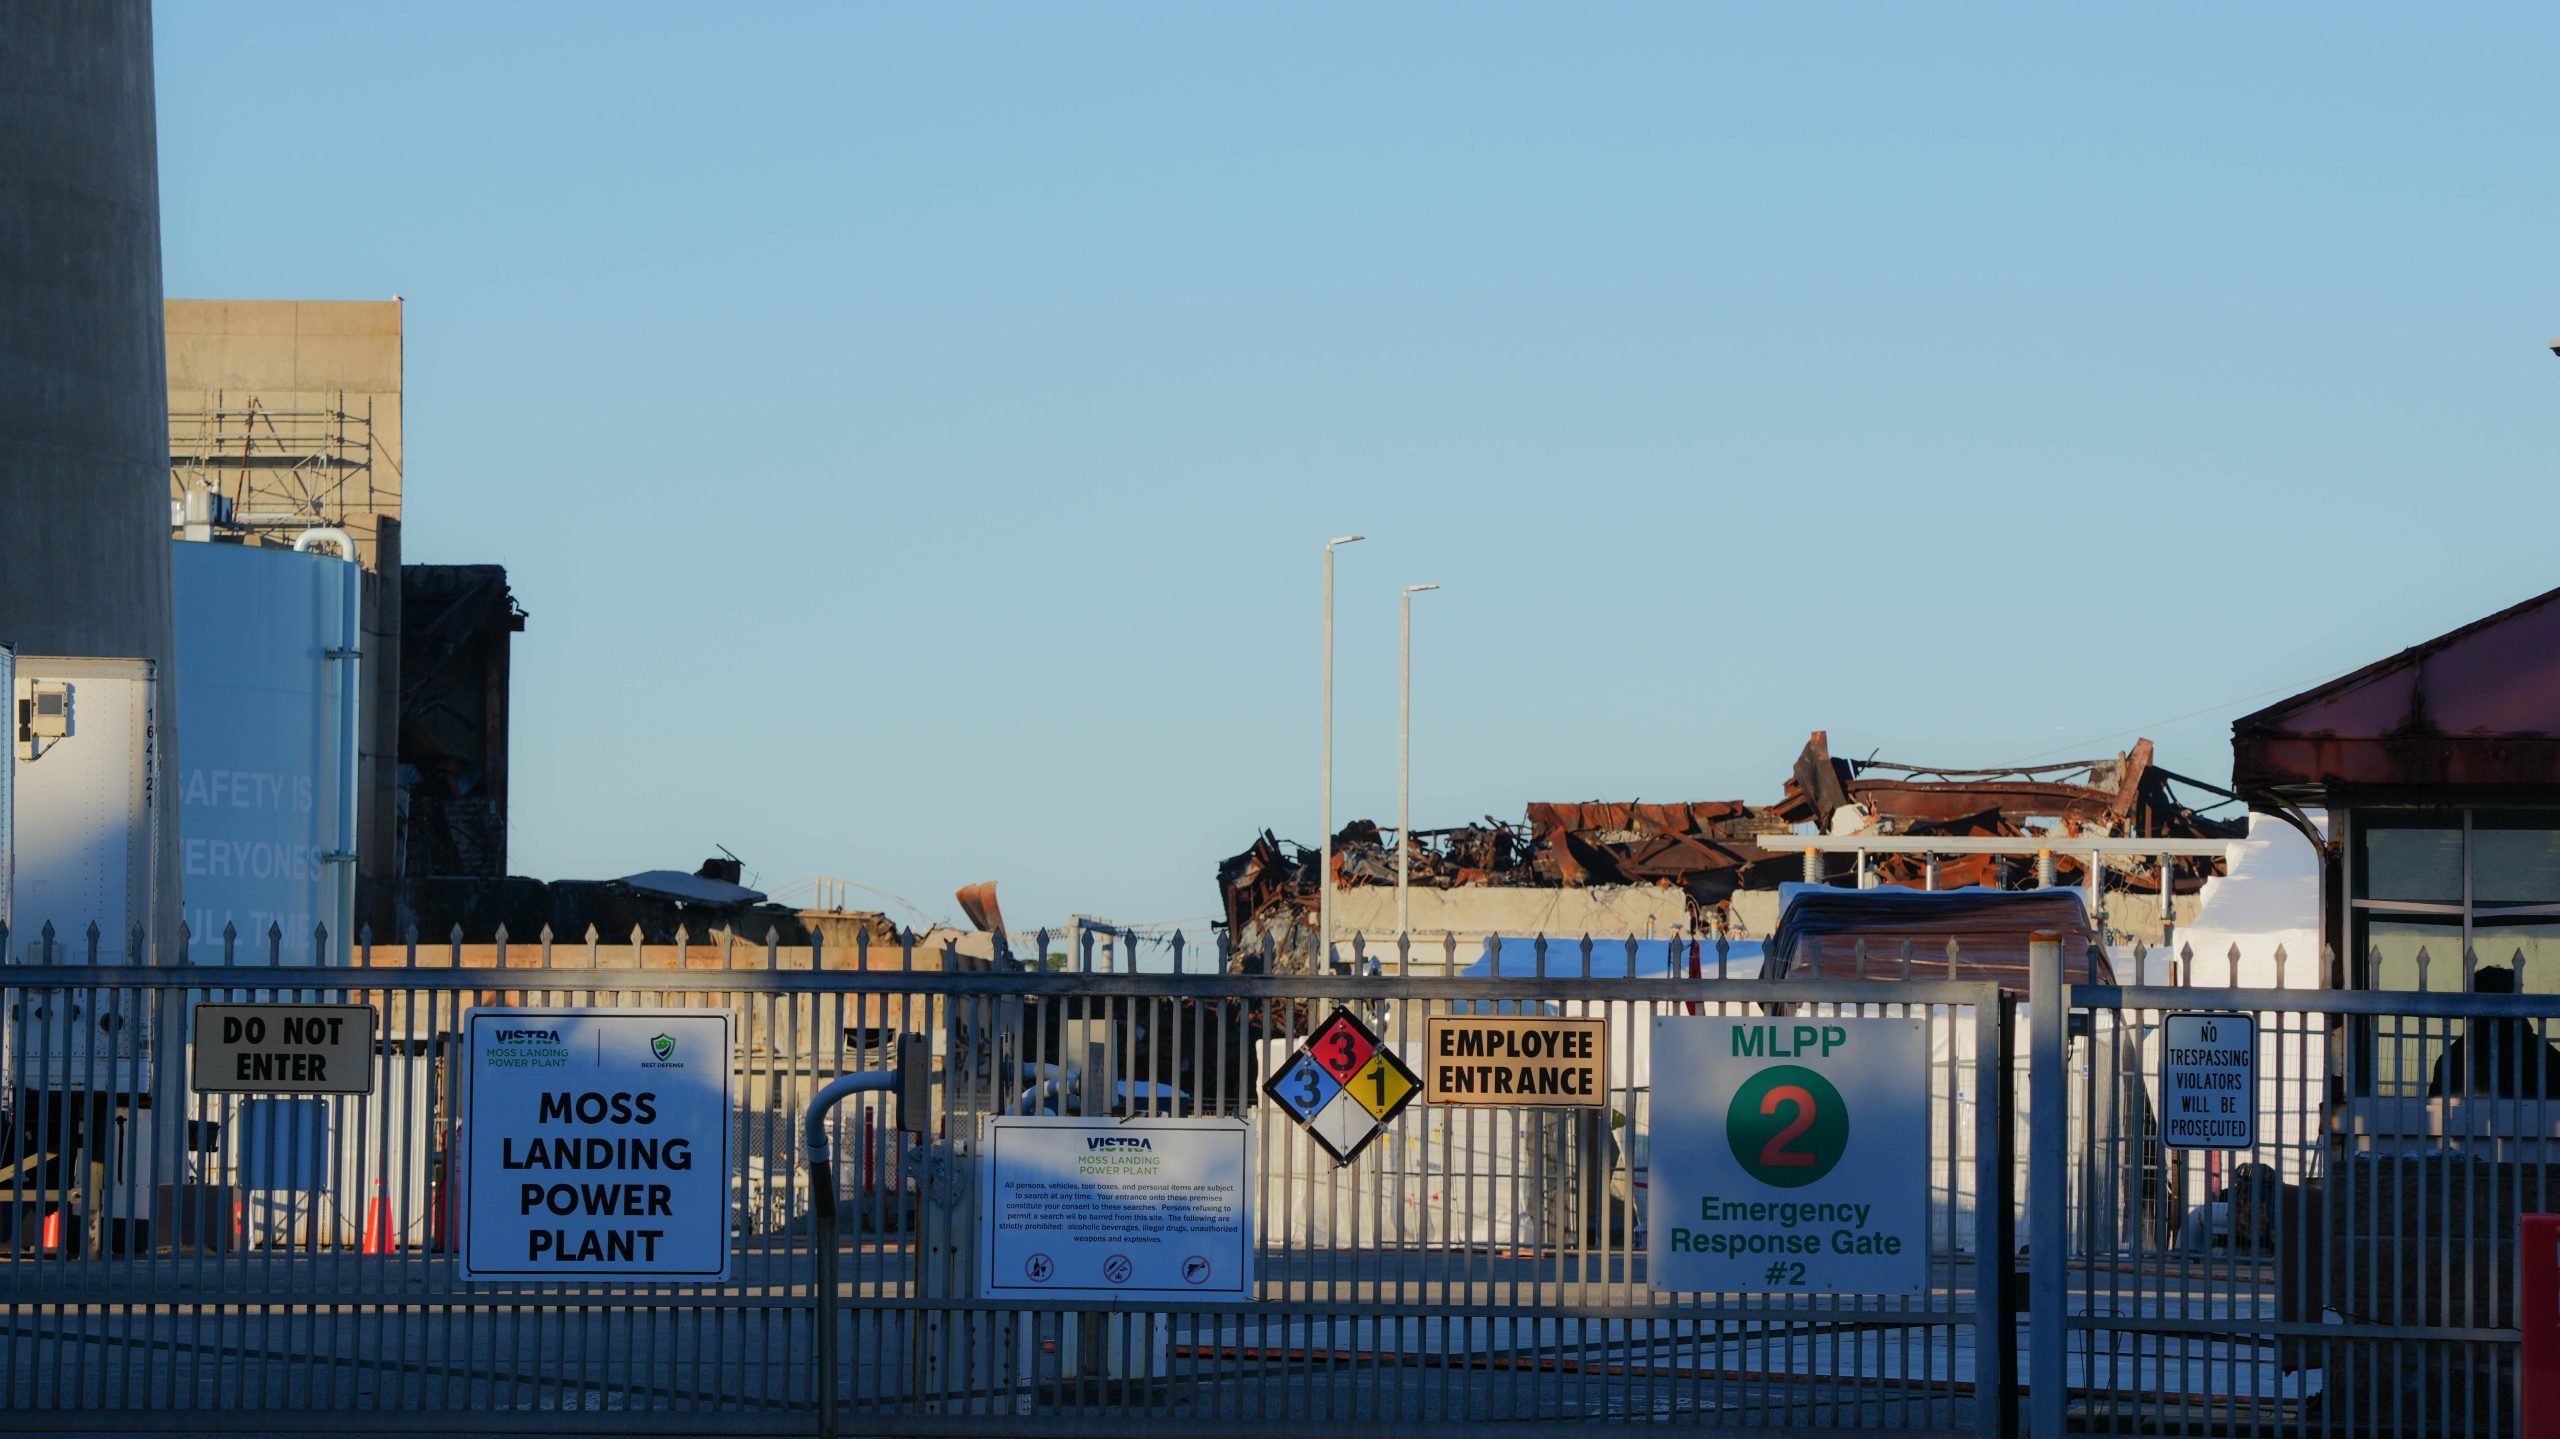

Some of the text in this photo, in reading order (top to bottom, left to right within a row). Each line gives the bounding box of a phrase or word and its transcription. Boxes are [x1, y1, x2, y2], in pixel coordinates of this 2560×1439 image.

[146, 708, 154, 808] 164121
[179, 768, 313, 813] AFETY IS
[180, 838, 322, 882] ERYONE'S
[224, 1016, 343, 1045] DO NOT
[495, 1030, 560, 1044] VISTRA
[1440, 1029, 1592, 1058] EMPLOYEE
[1732, 1025, 1847, 1058] MLPP
[2201, 1026, 2217, 1042] NO
[236, 1052, 327, 1081] ENTER
[487, 1048, 568, 1057] MOSS LANDING
[488, 1059, 567, 1067] POWER PLANT
[1329, 1032, 1356, 1072] 3
[2170, 1049, 2249, 1067] TRESPASSING
[1294, 1068, 1320, 1109] 3
[1366, 1067, 1386, 1107] 1
[1440, 1066, 1592, 1095] ENTRANCE
[2176, 1073, 2242, 1090] VIOLATORS
[539, 1092, 656, 1124] MOSS
[2182, 1096, 2236, 1113] WILL BE
[1760, 1084, 1816, 1166] 2
[2171, 1120, 2246, 1137] PROSECUTED
[503, 1138, 692, 1170] LANDING
[1087, 1137, 1152, 1152] VISTRA
[1078, 1156, 1160, 1165] MOSS LANDING
[1080, 1166, 1158, 1175] POWER PLANT
[521, 1183, 672, 1216] POWER
[1016, 1183, 1046, 1191] persons,
[1048, 1182, 1080, 1190] vehicles,
[1138, 1184, 1169, 1192] personal
[1207, 1185, 1234, 1193] subject
[1184, 1214, 1216, 1223] following
[1702, 1196, 1870, 1229] Emergency
[999, 1222, 1023, 1230] strictly
[1102, 1224, 1140, 1232] beverages,
[1166, 1225, 1188, 1233] drugs,
[529, 1230, 663, 1262] PLANT
[1672, 1228, 1901, 1259] Response Gate
[1764, 1262, 1806, 1286] #2
